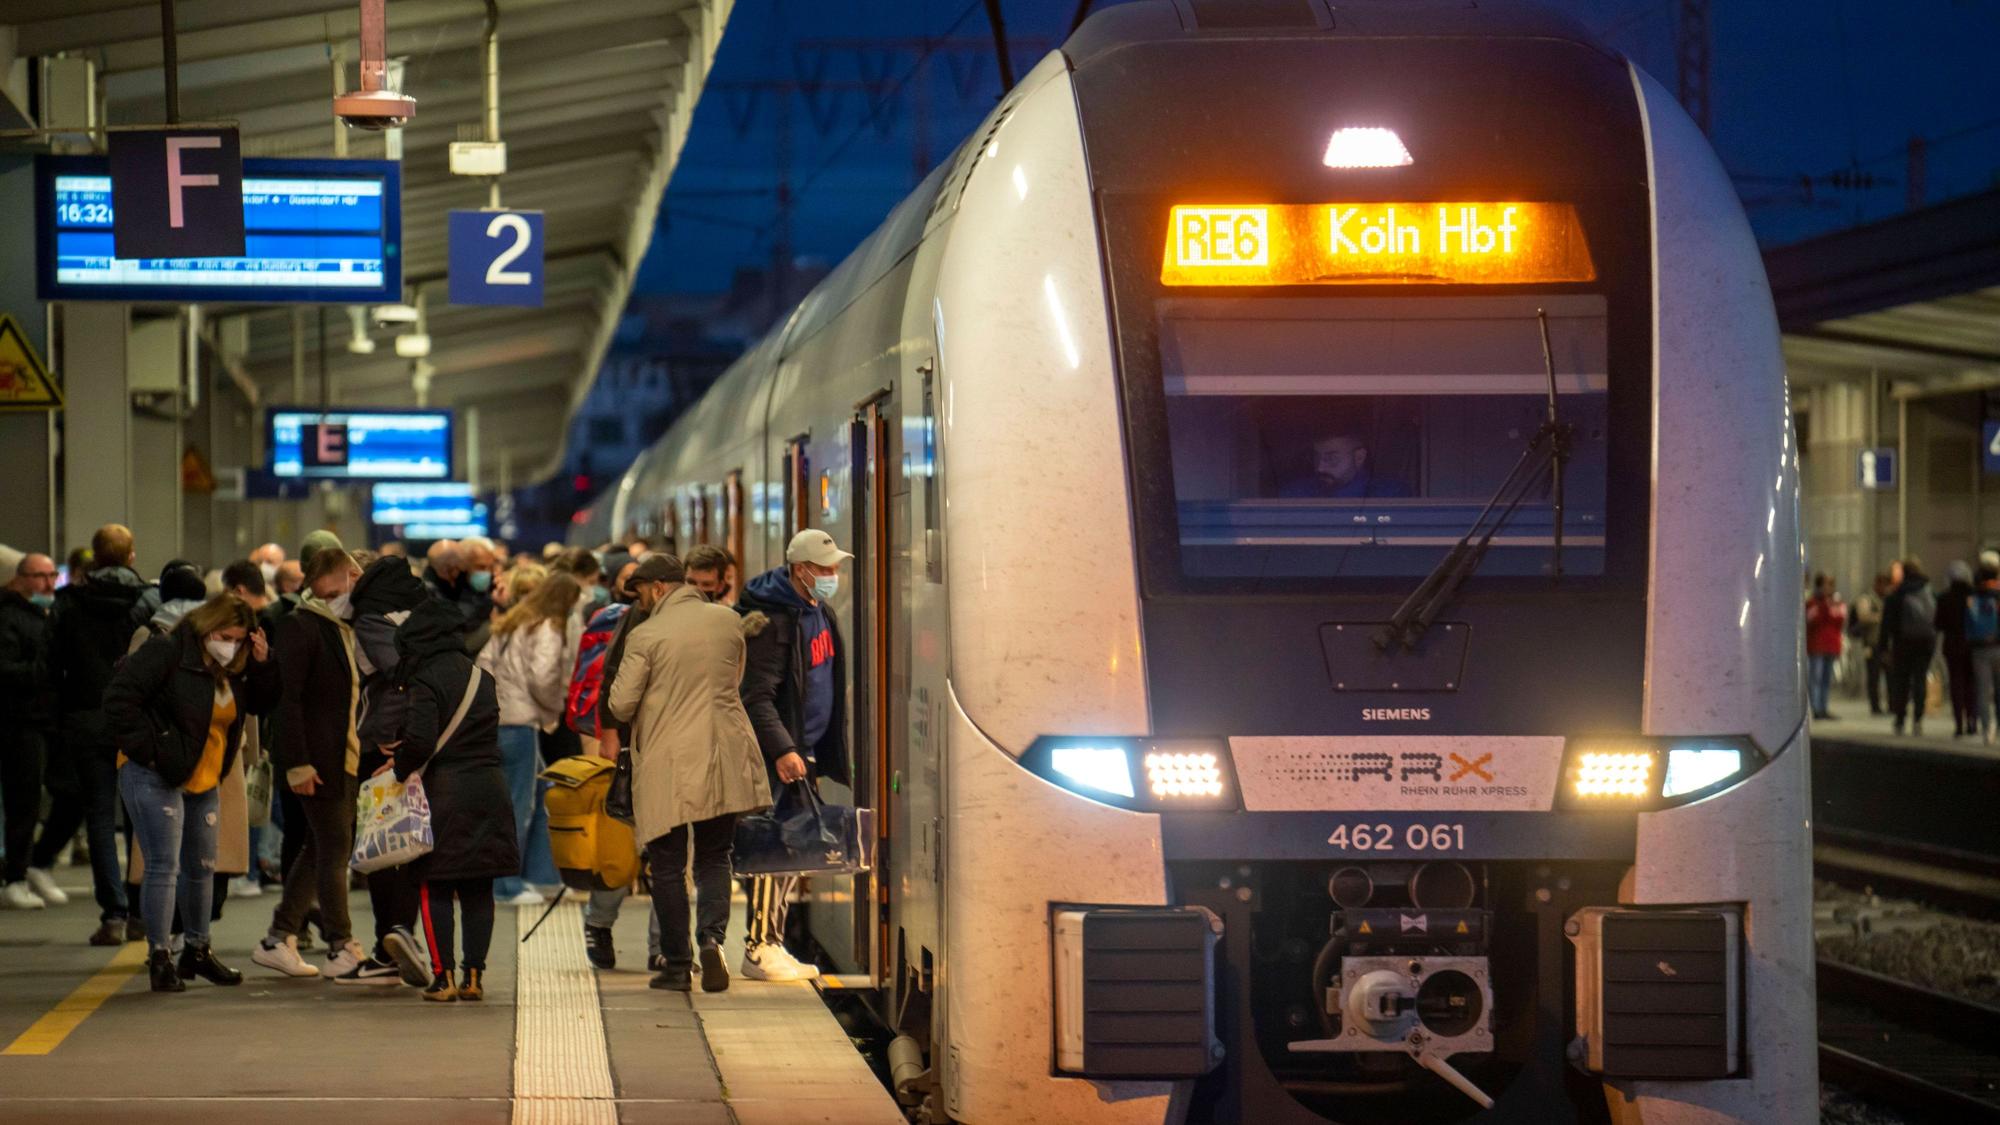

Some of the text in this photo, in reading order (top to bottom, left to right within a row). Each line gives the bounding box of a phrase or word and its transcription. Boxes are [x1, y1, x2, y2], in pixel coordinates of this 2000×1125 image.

[166, 136, 223, 229] F
[485, 213, 533, 285] 2
[1182, 206, 1517, 261] RE6 Köln Hbf
[317, 424, 343, 463] E
[1362, 708, 1431, 721] SIEMENS
[1351, 752, 1494, 782] RRX
[1400, 786, 1529, 796] RHEIN RUHR XPRESS
[1327, 823, 1465, 851] 462 061
